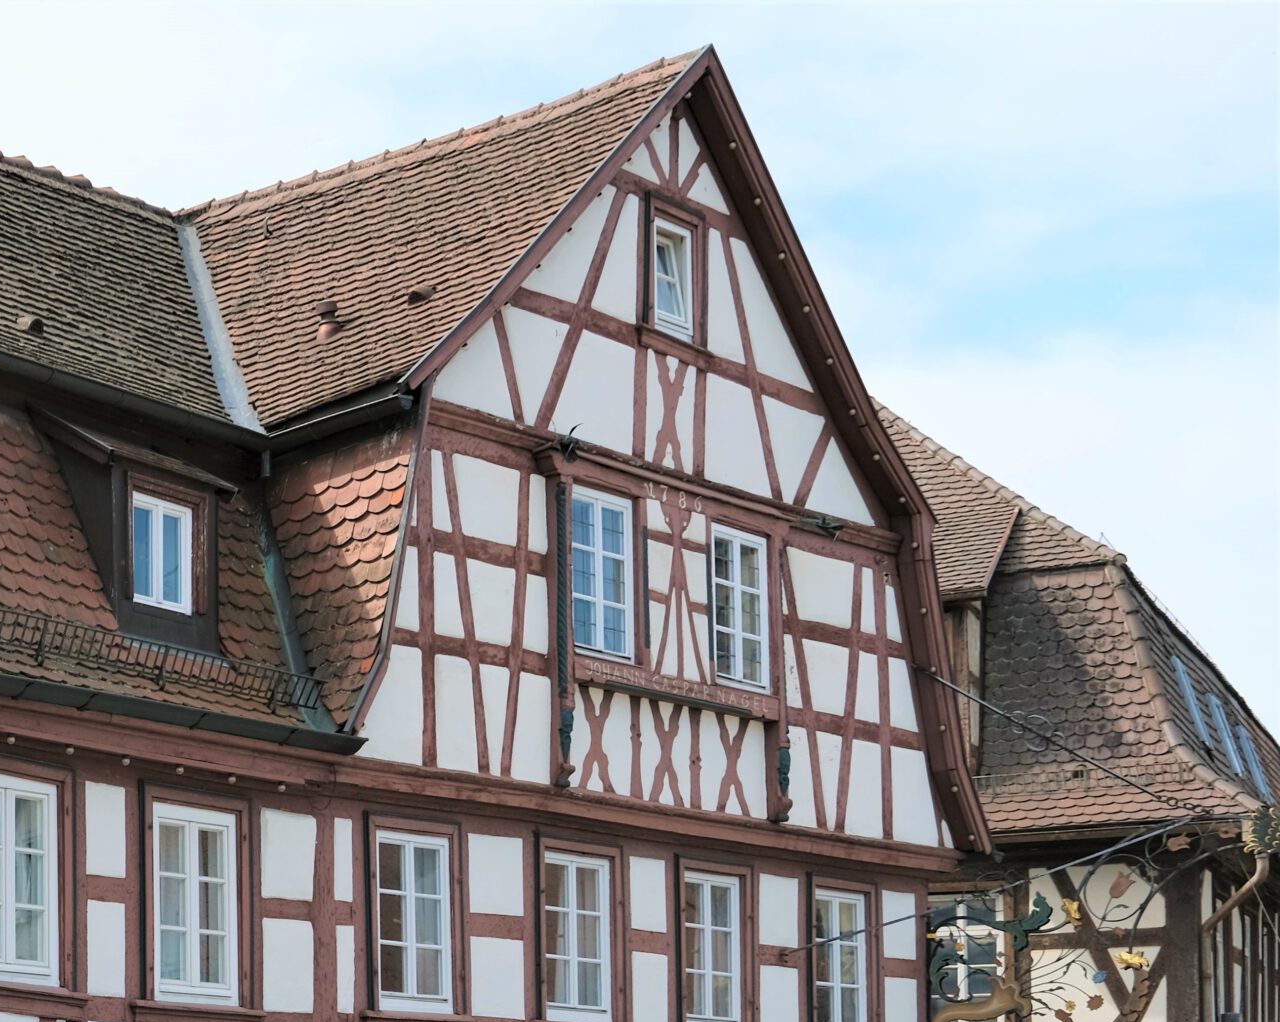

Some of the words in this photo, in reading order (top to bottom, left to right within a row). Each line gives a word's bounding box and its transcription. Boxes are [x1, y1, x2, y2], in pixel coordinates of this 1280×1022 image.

[585, 660, 645, 687] JOHANN
[652, 675, 711, 701] CASPAR
[717, 689, 769, 713] NAGEL
